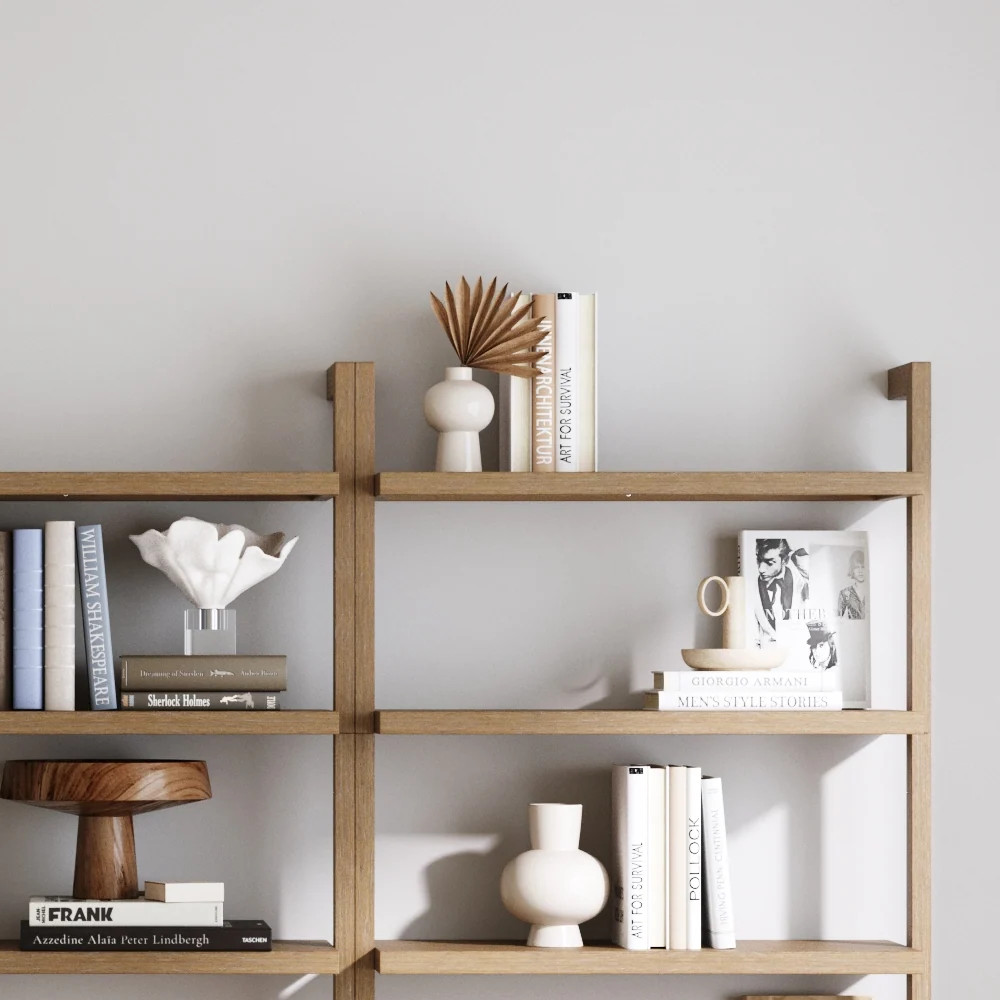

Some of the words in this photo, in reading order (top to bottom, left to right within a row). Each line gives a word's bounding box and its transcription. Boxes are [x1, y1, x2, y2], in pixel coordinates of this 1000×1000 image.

[560, 367, 572, 414] SURVIVAL
[560, 418, 572, 440] FOR
[560, 444, 572, 464] ART
[80, 528, 100, 599] WILLIAM
[86, 602, 111, 706] SHAKESPEARE
[691, 676, 748, 687] GIORGIO
[753, 676, 807, 687] ARMANI
[147, 693, 181, 707] Sherlock
[182, 693, 211, 707] Holmes
[677, 696, 720, 708] MEN'S
[723, 696, 767, 708] STYLE
[769, 696, 828, 708] STORIES
[631, 842, 643, 890] SURVIVAL
[688, 817, 700, 901] POLLOCK
[631, 891, 643, 915] FOR
[48, 907, 114, 922] FRANK
[631, 920, 642, 939] ART
[32, 934, 84, 945] Azzedine
[87, 934, 117, 945] Alaïa
[121, 934, 150, 945] Peter
[153, 934, 210, 948] Lindbergh
